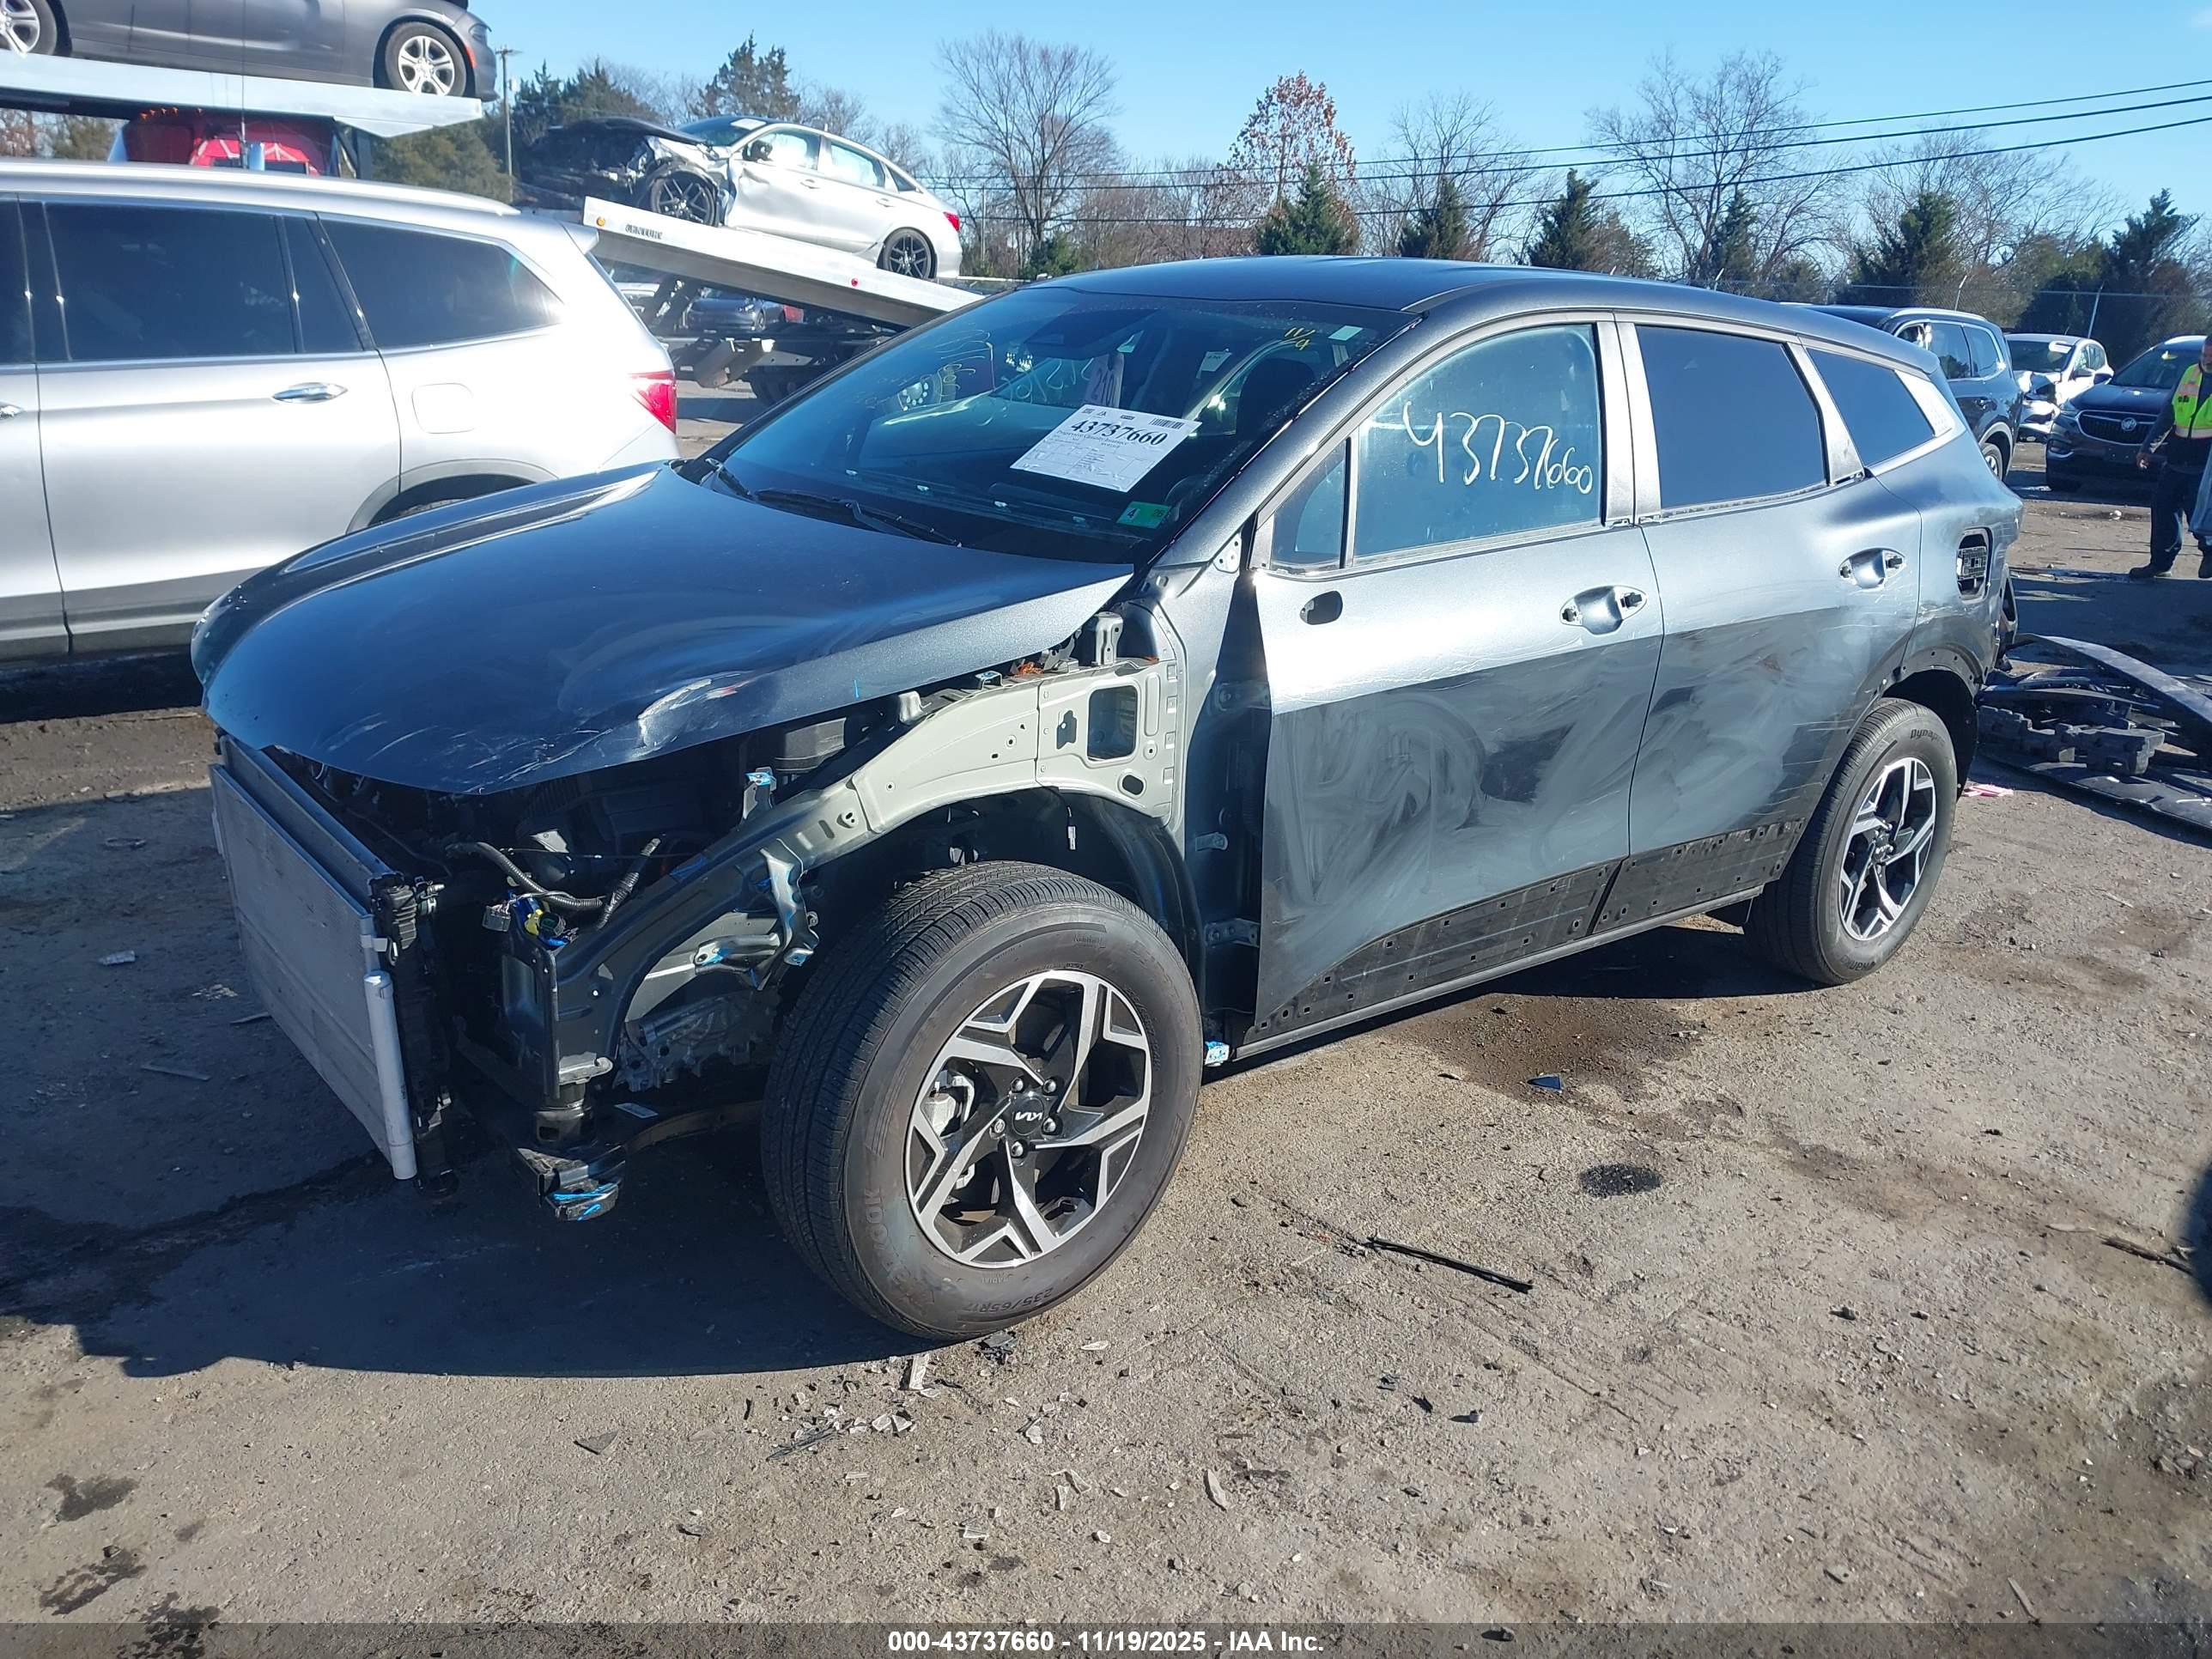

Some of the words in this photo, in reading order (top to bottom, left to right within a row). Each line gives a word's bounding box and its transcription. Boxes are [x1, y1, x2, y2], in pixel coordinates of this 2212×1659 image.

[1071, 420, 1169, 447] 43737660
[1402, 400, 1593, 495] 43737660
[1014, 1110, 1043, 1121] KIA
